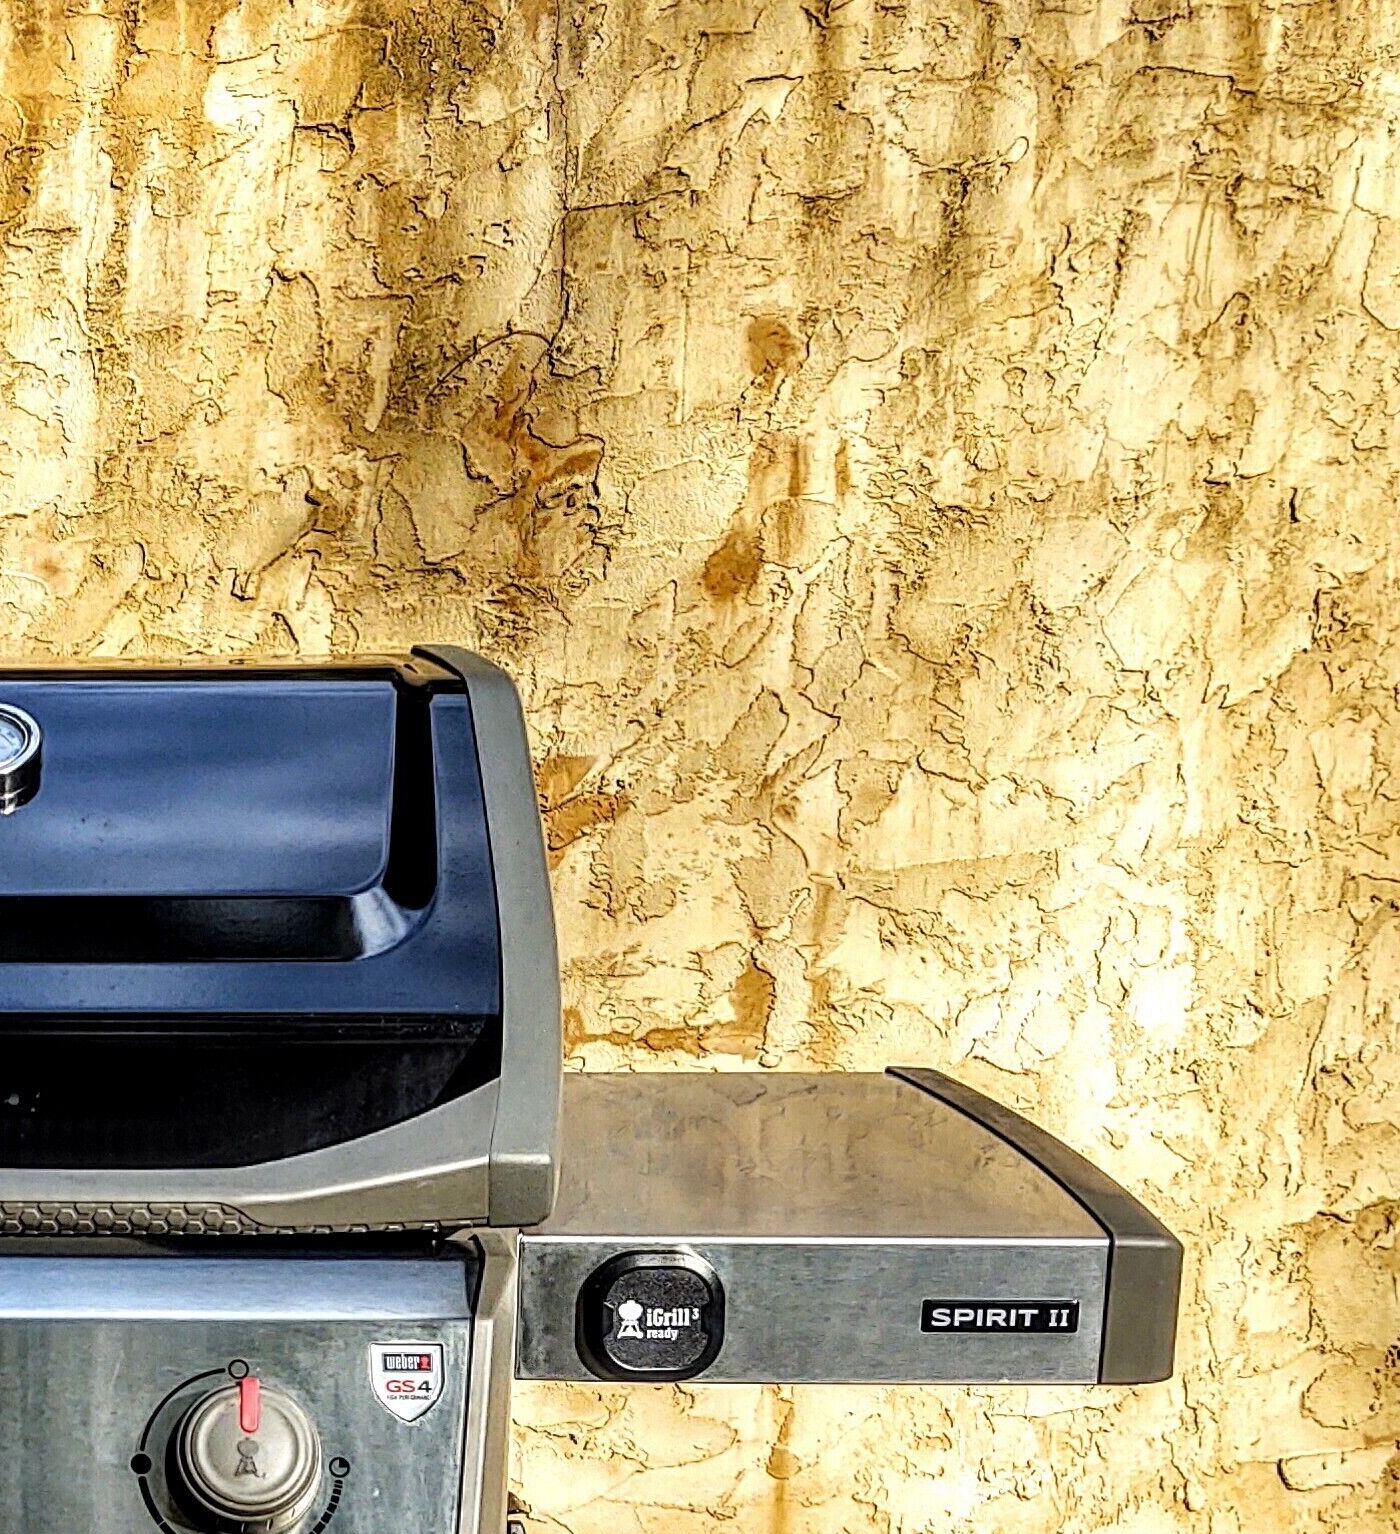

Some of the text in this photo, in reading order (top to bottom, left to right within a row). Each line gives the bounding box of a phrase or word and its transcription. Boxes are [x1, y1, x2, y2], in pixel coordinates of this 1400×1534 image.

[931, 1308, 1070, 1327] SPIRIT II
[646, 1326, 679, 1341] ready
[386, 1353, 420, 1370] weber
[386, 1380, 432, 1393] GS4
